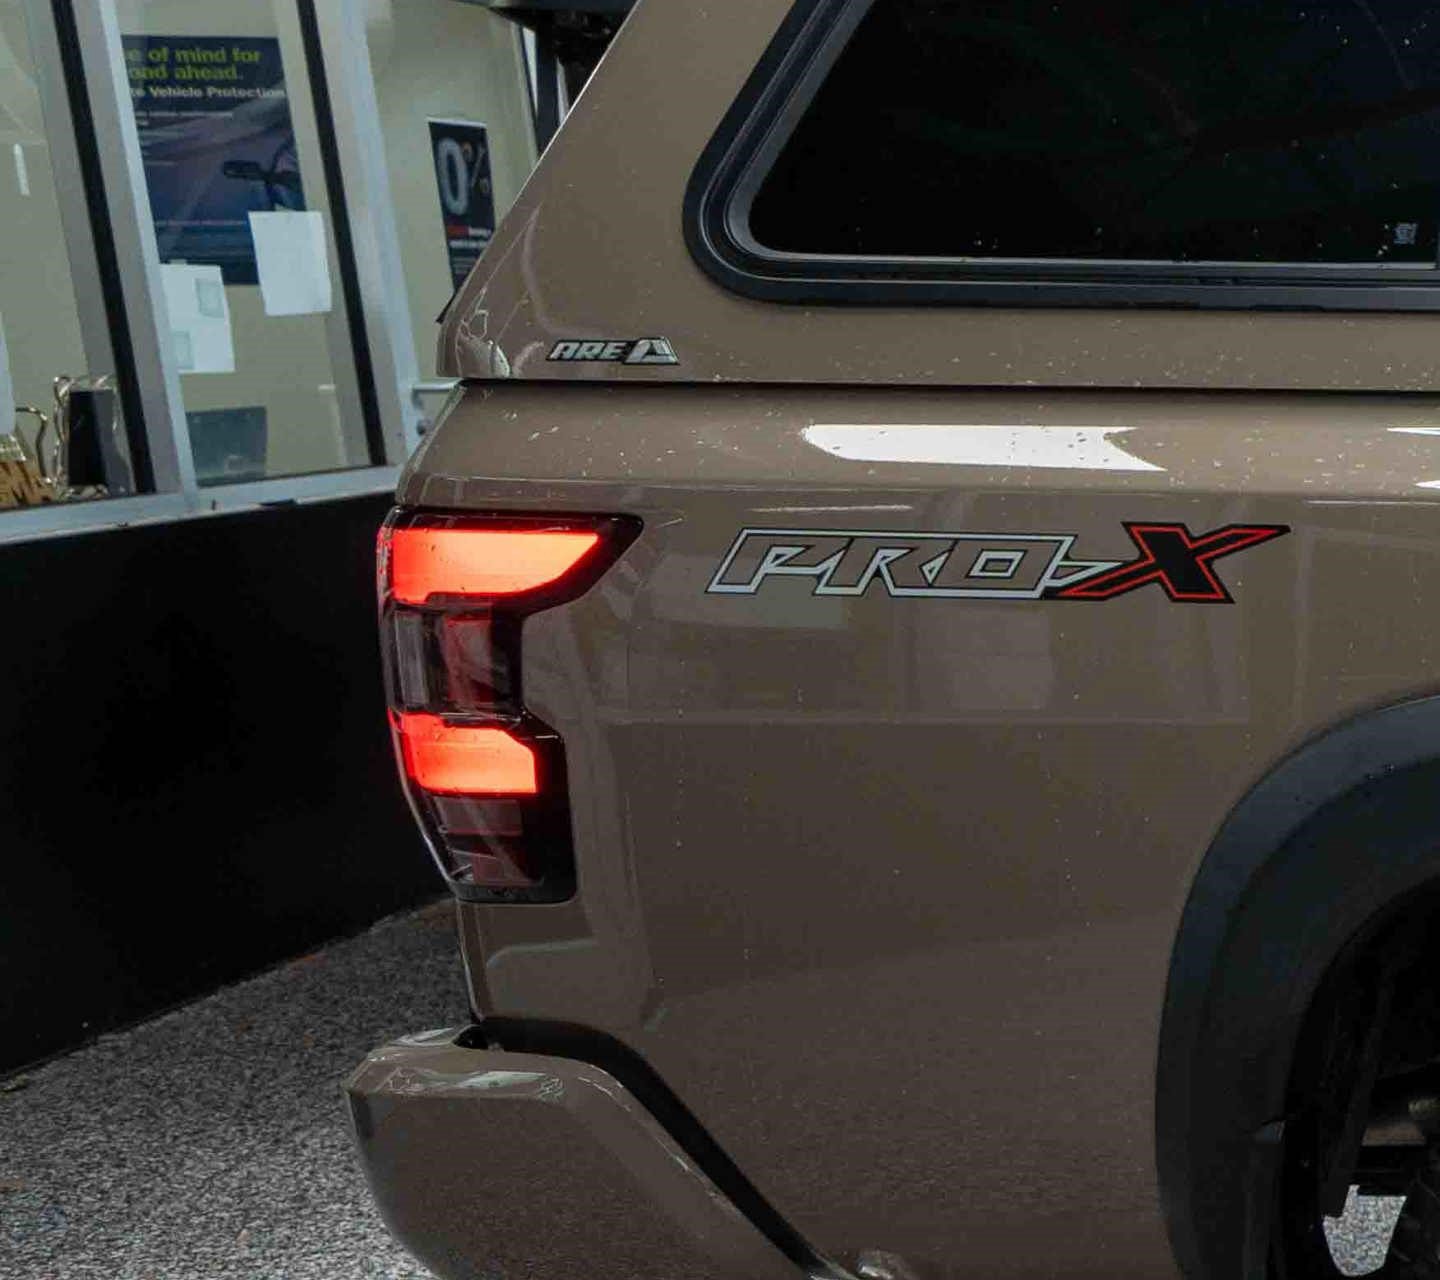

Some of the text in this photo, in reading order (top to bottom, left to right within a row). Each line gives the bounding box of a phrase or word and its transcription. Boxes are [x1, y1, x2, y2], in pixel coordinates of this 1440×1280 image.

[147, 48, 169, 62] of
[175, 47, 226, 62] mind
[231, 48, 263, 62] for
[150, 87, 203, 98] Vehicle
[207, 87, 287, 99] Protection
[436, 136, 491, 216] 0%
[549, 341, 628, 360] ARE
